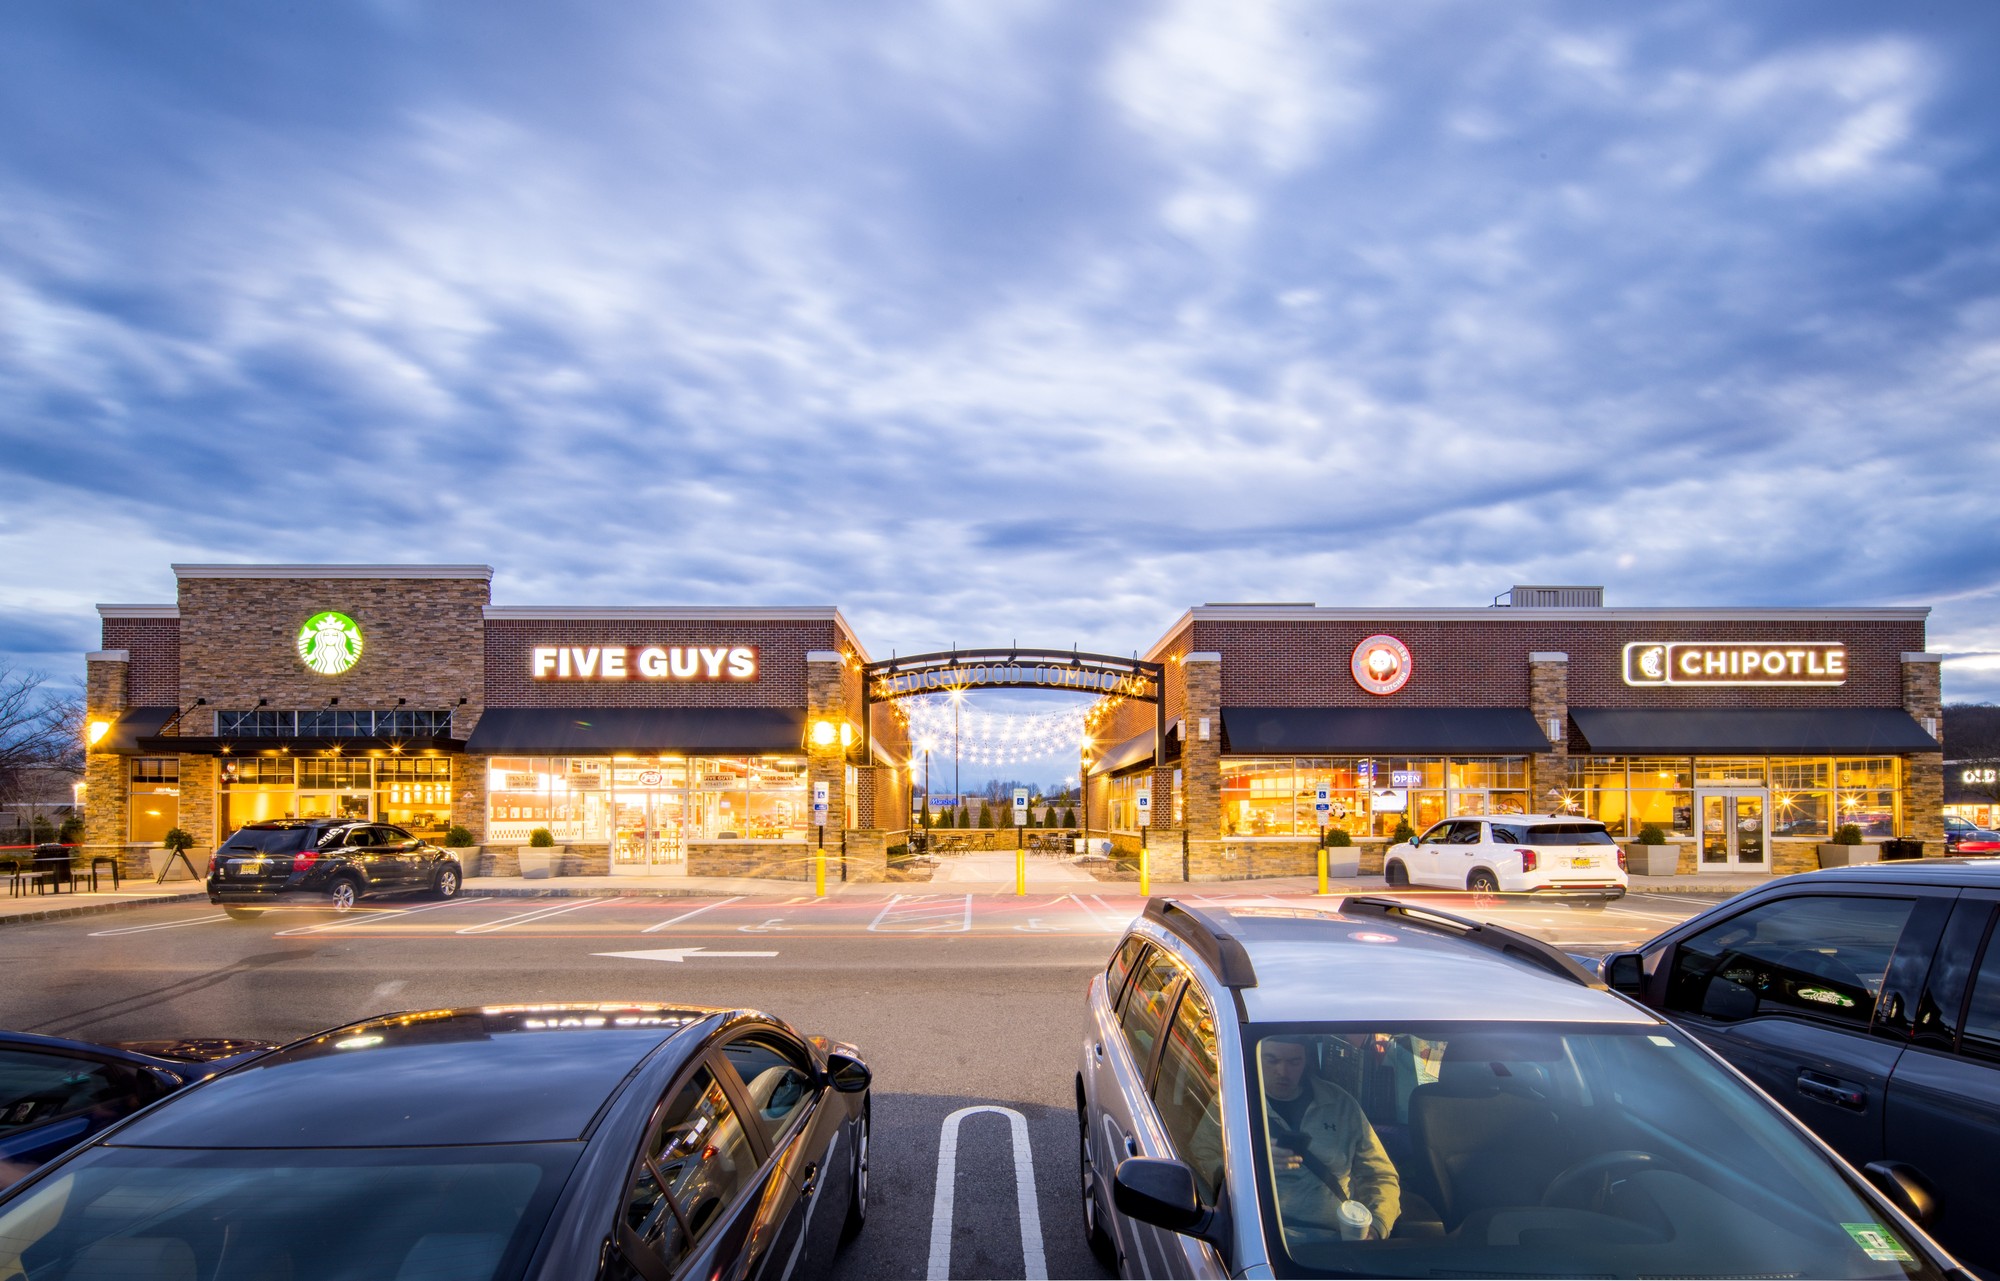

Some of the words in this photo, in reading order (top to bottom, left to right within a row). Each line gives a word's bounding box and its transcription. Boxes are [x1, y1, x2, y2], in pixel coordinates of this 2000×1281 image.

[533, 648, 627, 677] FIVE
[638, 647, 755, 678] GUYS
[1680, 651, 1845, 674] CHIPOTLE
[892, 663, 1023, 695] EDGEWOOD
[1033, 663, 1145, 697] COMMONS
[1382, 671, 1407, 692] KITCHEN
[1393, 775, 1420, 783] OPEN
[1963, 769, 1996, 783] OLD
